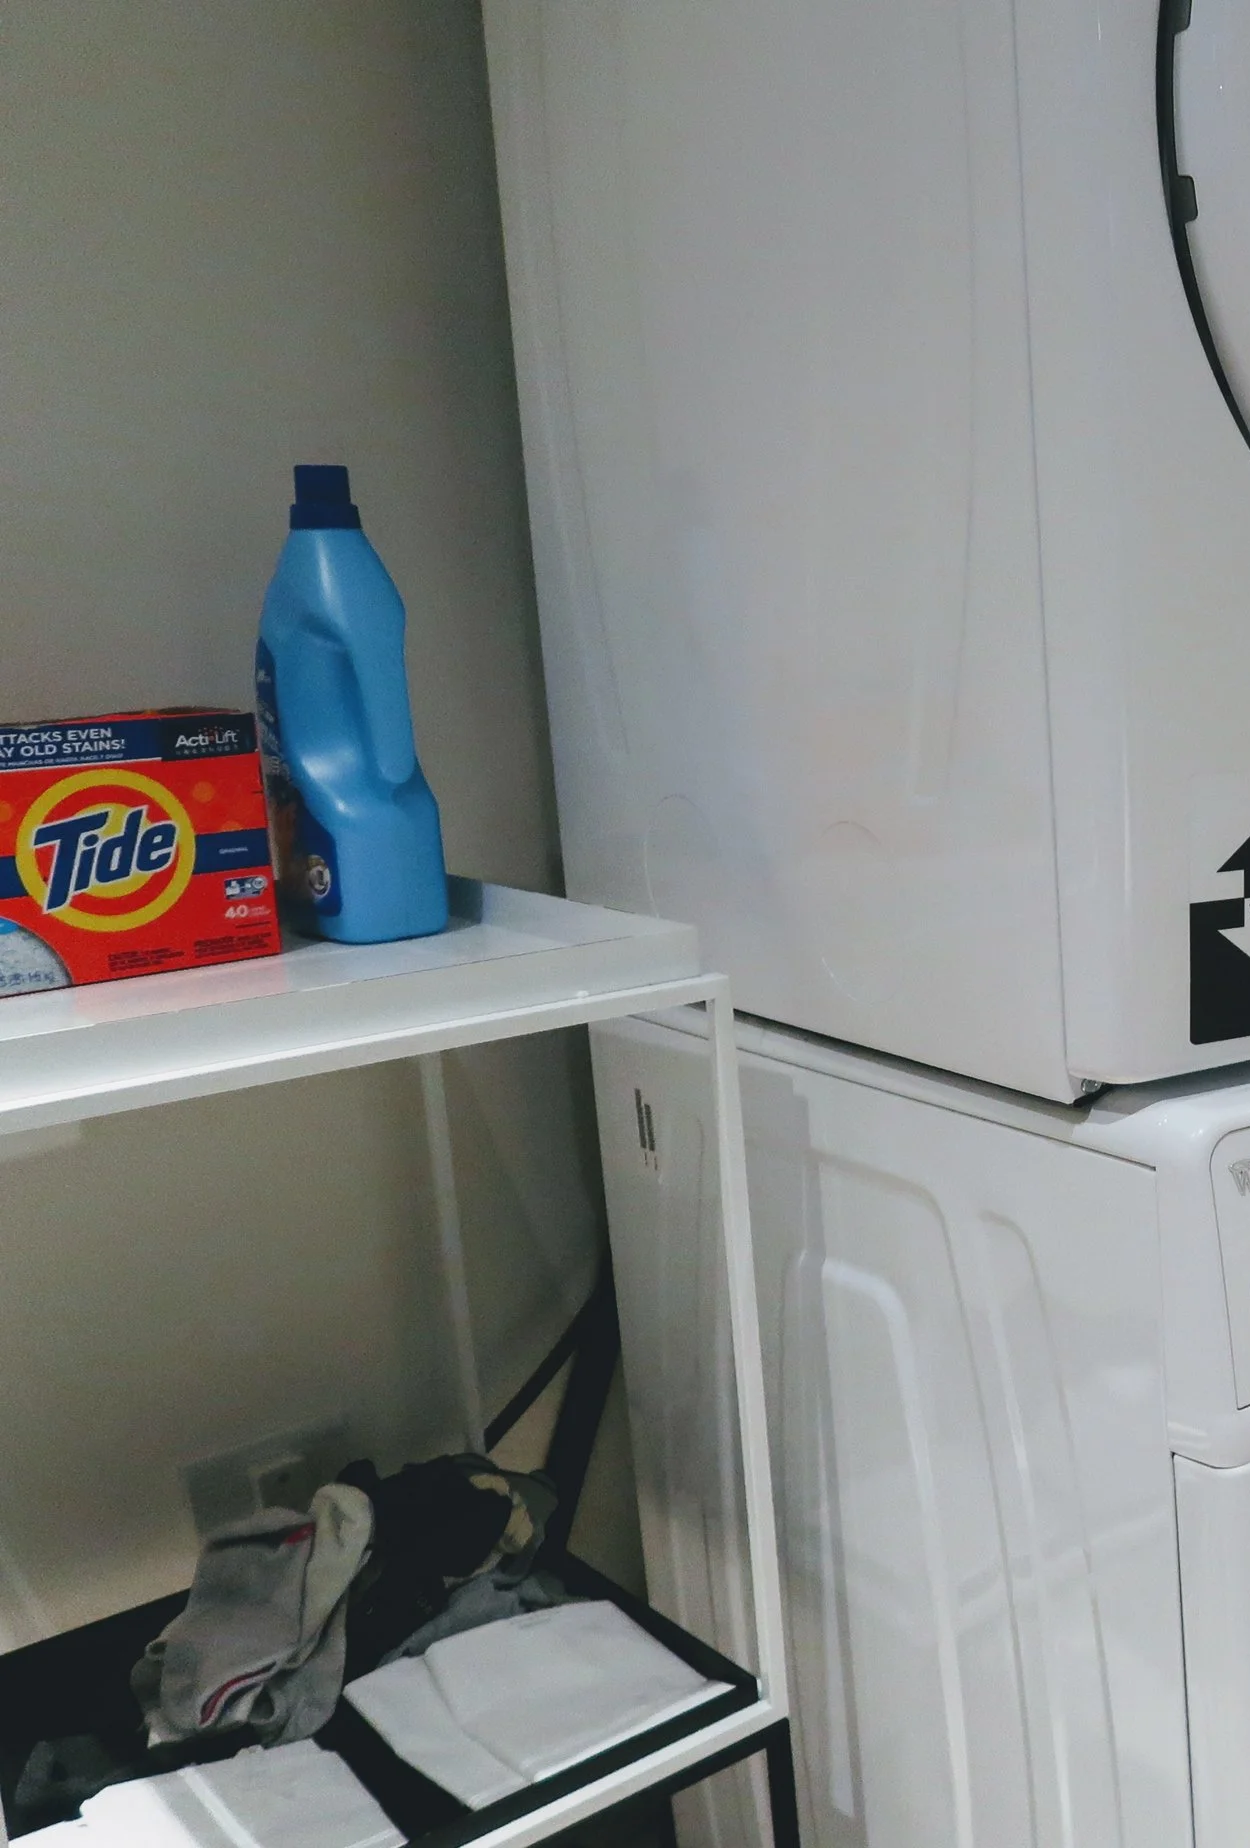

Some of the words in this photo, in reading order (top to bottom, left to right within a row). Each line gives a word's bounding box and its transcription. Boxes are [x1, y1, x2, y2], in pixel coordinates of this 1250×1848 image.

[67, 728, 113, 741] EVEN
[20, 744, 57, 757] OLD
[62, 739, 125, 754] STAINS!
[34, 806, 177, 913] Tide
[225, 904, 249, 918] 40
